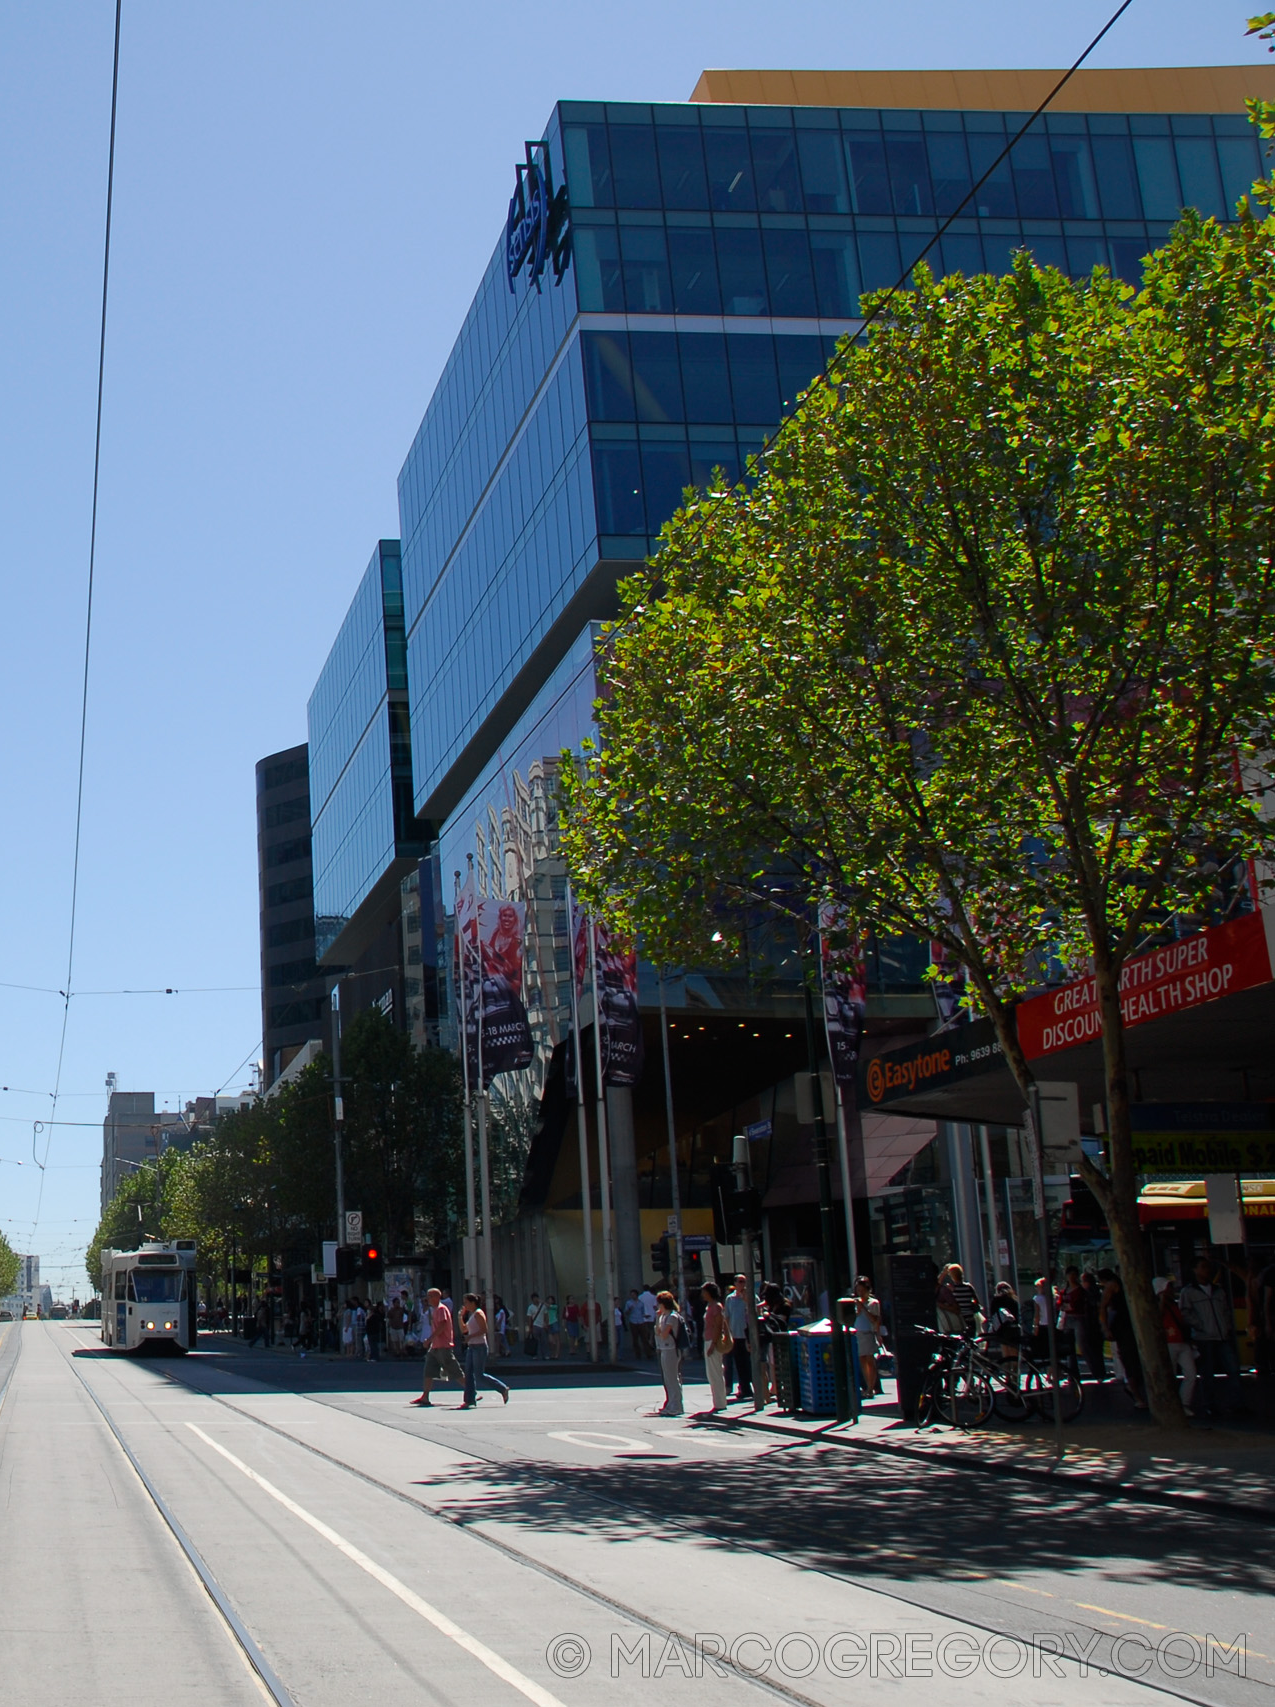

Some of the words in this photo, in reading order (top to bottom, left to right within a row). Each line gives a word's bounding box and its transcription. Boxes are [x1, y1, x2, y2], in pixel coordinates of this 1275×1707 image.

[508, 189, 540, 273] sensis
[1043, 1012, 1103, 1050] DISCOUN
[1120, 984, 1181, 1022] HEALTH
[1185, 964, 1233, 1002] SHOP
[1054, 981, 1098, 1016] GREAT
[1117, 958, 1152, 993] RTH
[1156, 937, 1208, 978] SUPER
[885, 1049, 951, 1091] Easytone
[955, 1054, 969, 1067] Ph:
[970, 1043, 991, 1060] 9639
[1178, 1139, 1241, 1166] Mobile
